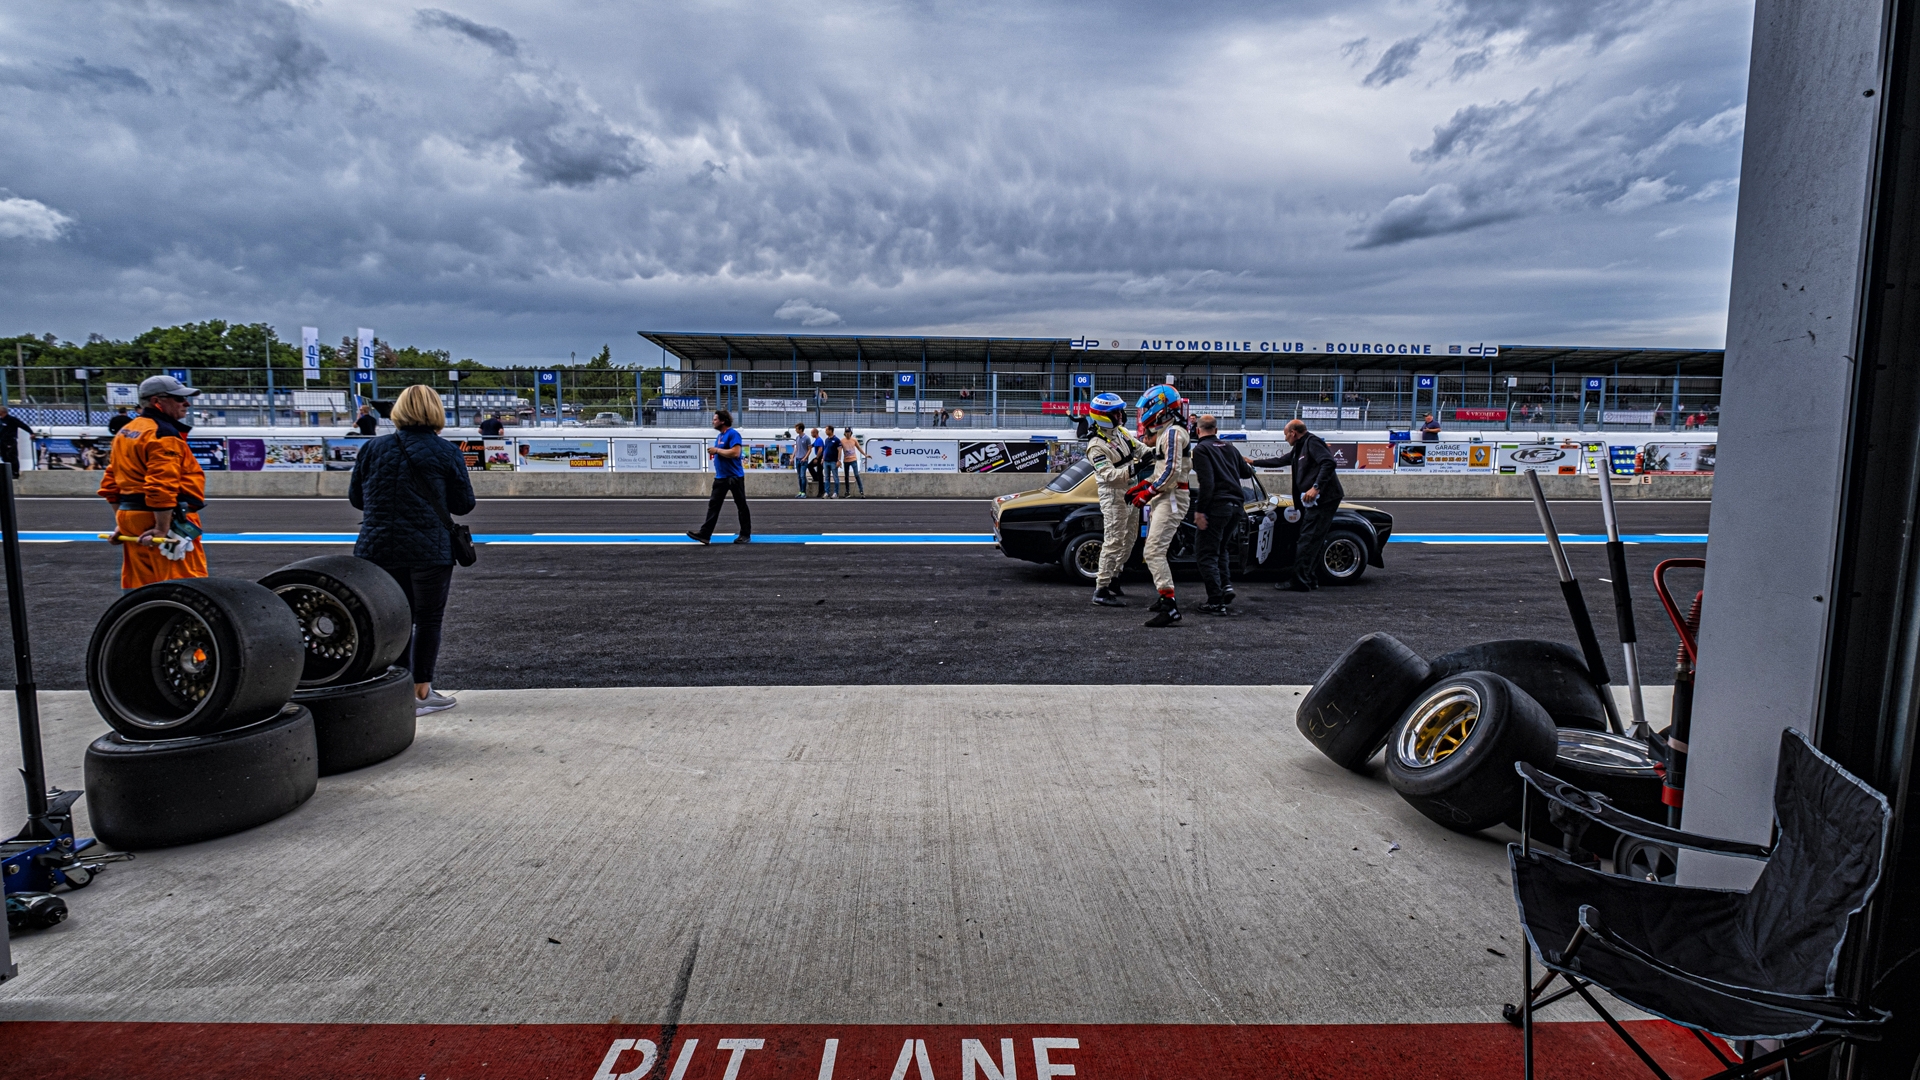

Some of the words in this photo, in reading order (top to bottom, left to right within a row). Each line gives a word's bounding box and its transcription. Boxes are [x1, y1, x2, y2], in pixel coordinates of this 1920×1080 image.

[1070, 335, 1100, 352] dp
[1141, 340, 1252, 351] AUTOMOBILE
[1260, 341, 1304, 352] CLUB
[1326, 342, 1432, 354] BOURGOGNE
[1468, 343, 1498, 359] dp
[358, 372, 368, 380] 10
[542, 373, 553, 381] 09
[723, 374, 734, 382] 08
[901, 375, 912, 383] 07
[1077, 376, 1088, 384] 06
[1250, 377, 1260, 385] 05
[1421, 378, 1431, 386] 04
[662, 397, 701, 410] NOSTALGIE
[964, 443, 1000, 468] AVS
[1012, 450, 1027, 460] EXPERT
[1020, 449, 1047, 463] MARQUAGE
[966, 454, 1003, 473] COMMUNICATION
